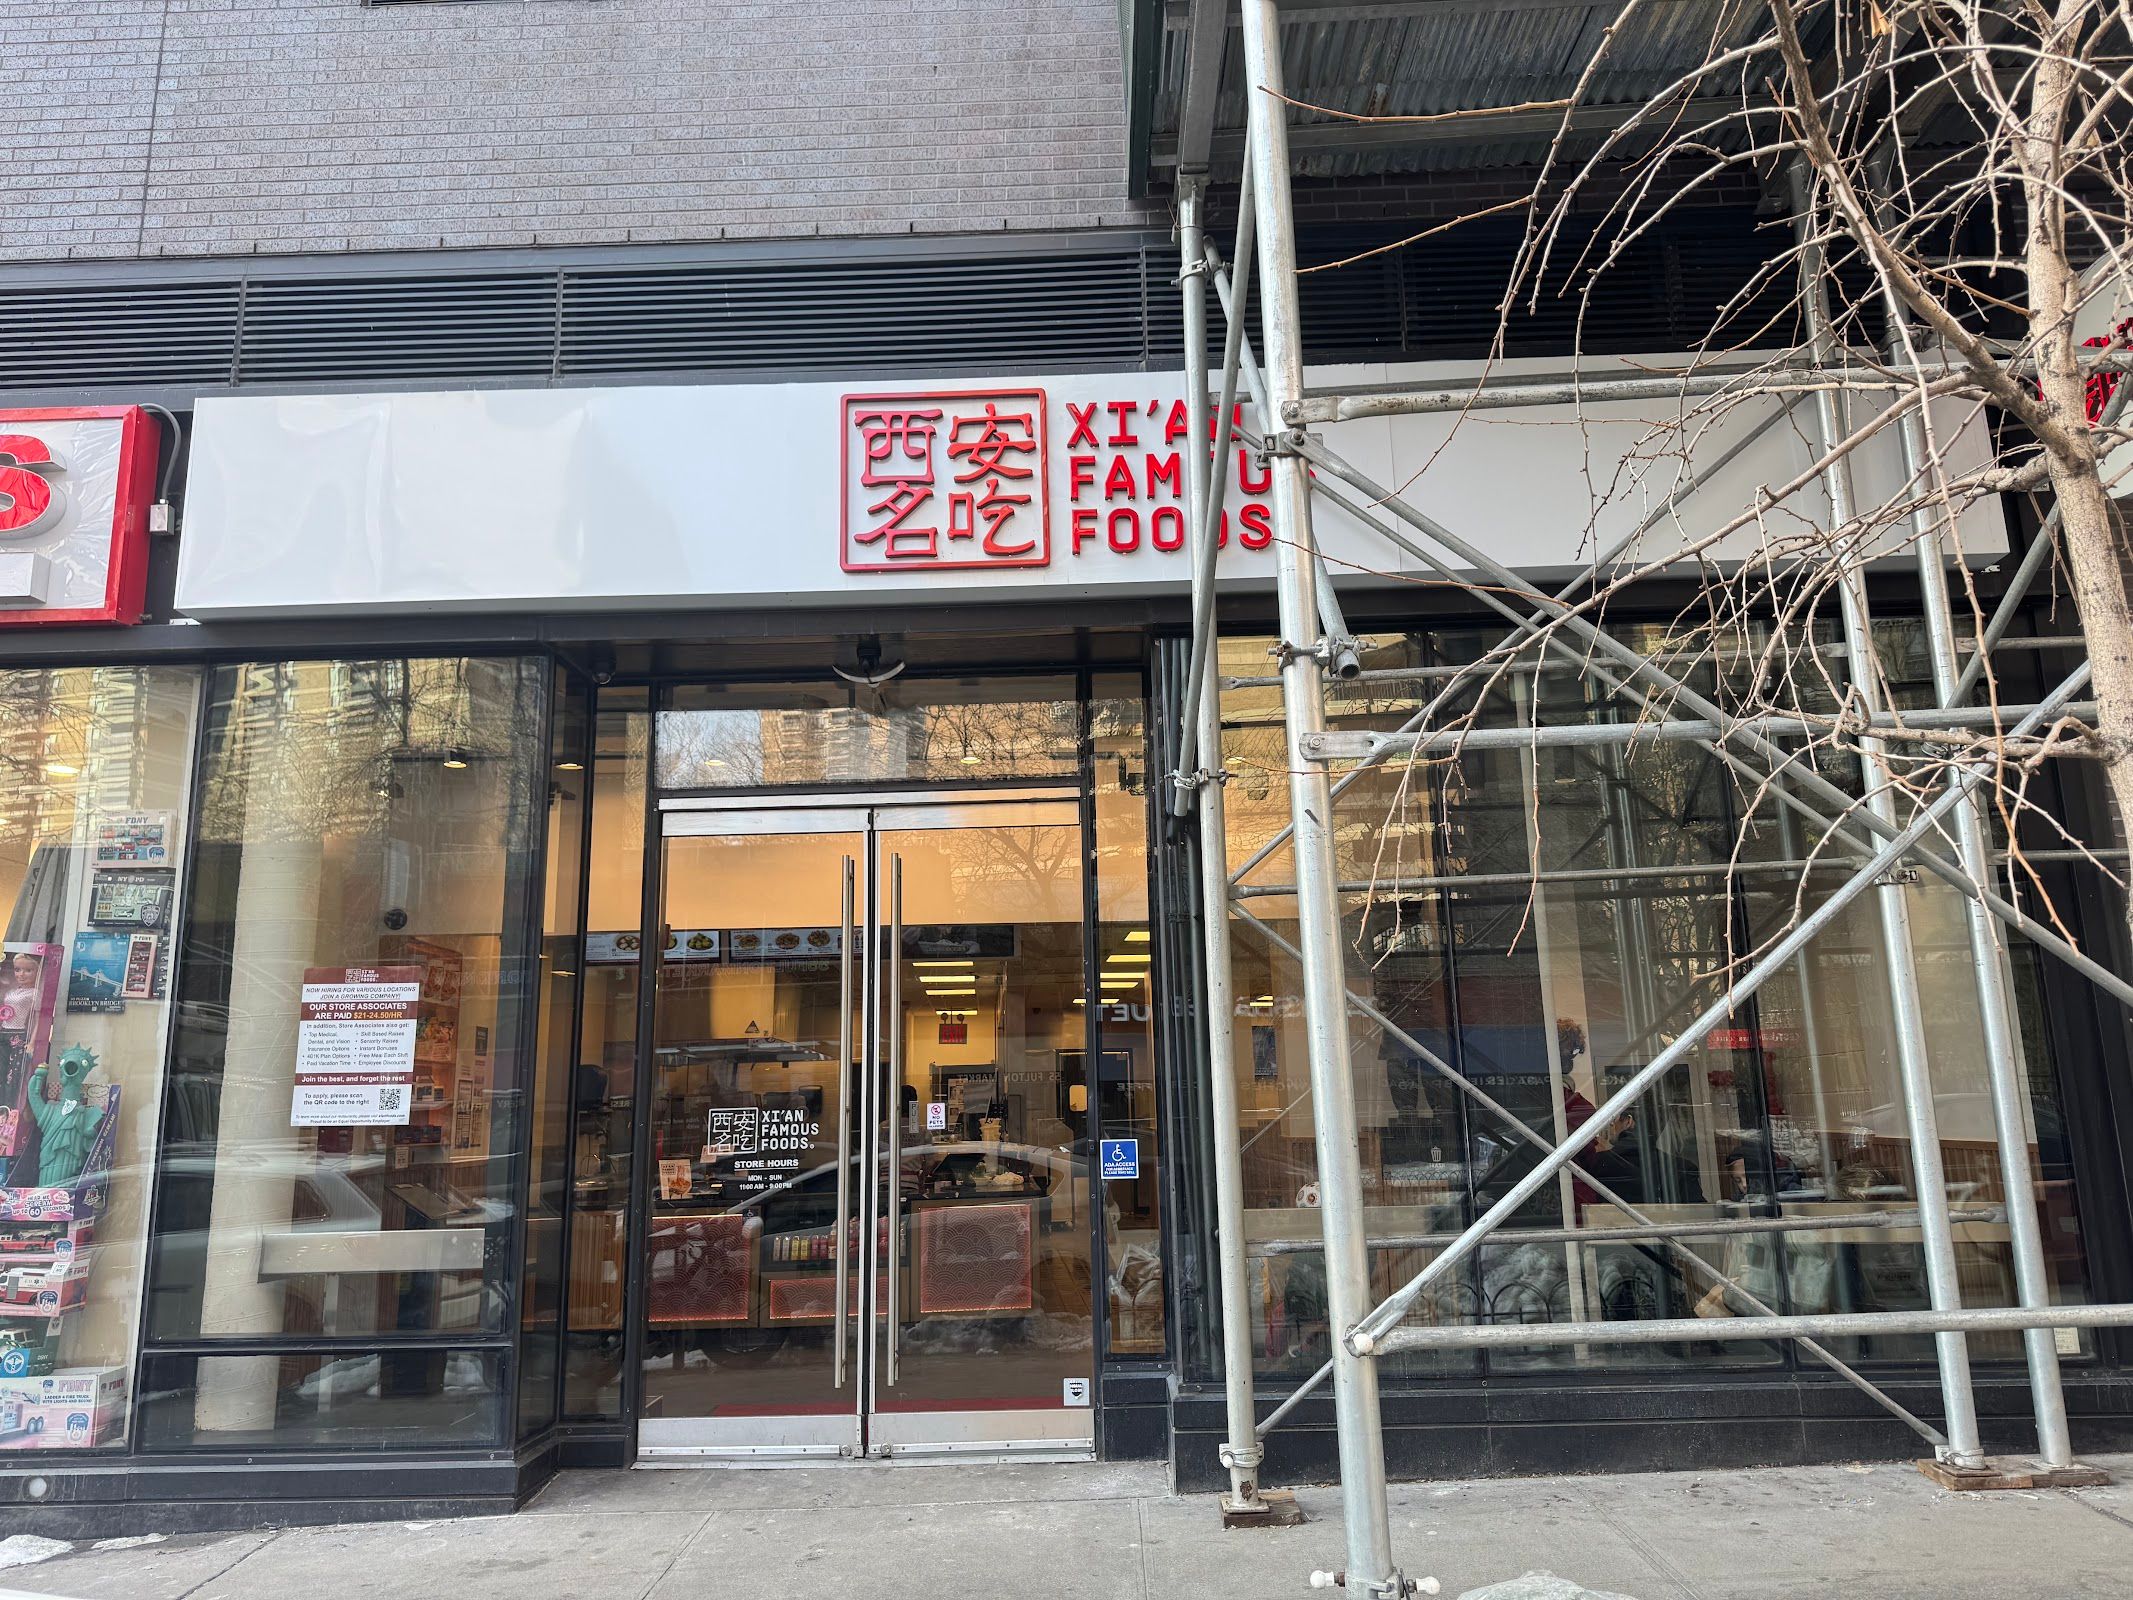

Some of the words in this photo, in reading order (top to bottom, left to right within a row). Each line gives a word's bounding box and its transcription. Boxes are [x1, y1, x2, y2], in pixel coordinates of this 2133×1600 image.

[854, 403, 1036, 487] 西安
[1070, 449, 1315, 501] FAMU
[854, 479, 1036, 558] 名吃
[309, 1003, 327, 1011] OUR
[357, 1002, 407, 1010] ASSOCIATES
[315, 1012, 332, 1020] ARE
[762, 1110, 804, 1122] XI'AN
[762, 1123, 819, 1136] FAMOUS
[768, 1159, 799, 1167] HOURS
[25, 1200, 52, 1208] SCREAM
[59, 1380, 93, 1392] FDNY
